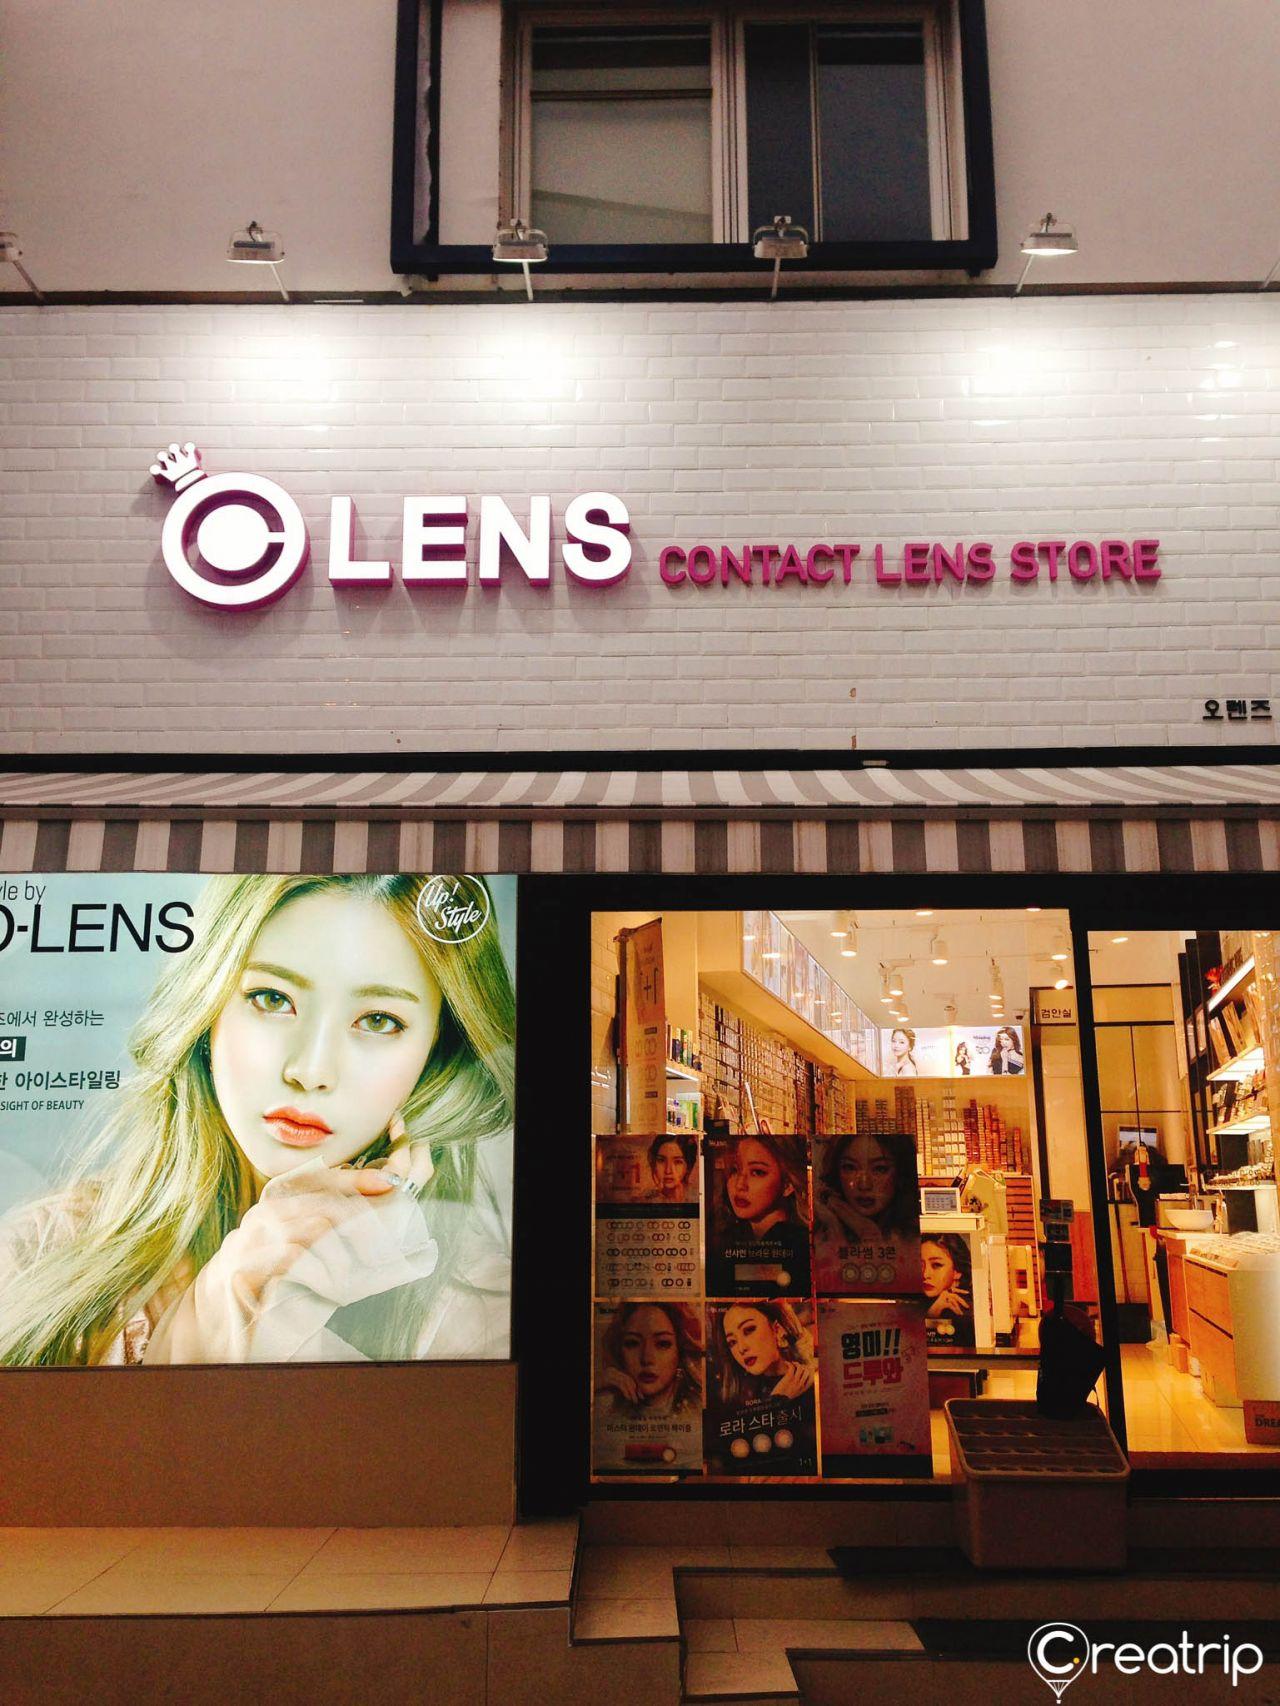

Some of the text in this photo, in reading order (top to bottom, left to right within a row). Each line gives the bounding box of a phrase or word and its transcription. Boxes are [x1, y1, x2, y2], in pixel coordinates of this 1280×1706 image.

[658, 539, 1163, 587] CONTACT LENS STORE
[1203, 700, 1272, 721] 오렌즈
[24, 880, 46, 905] by
[425, 882, 460, 912] Up!
[434, 901, 482, 933] Style
[43, 1010, 105, 1027] 완성하는
[1041, 1008, 1072, 1018] 검안실
[15, 1070, 121, 1090] 아이스타일링
[31, 1100, 44, 1111] OF
[46, 1100, 85, 1111] BEAUTY
[720, 1417, 746, 1438] 로라
[748, 1411, 775, 1430] 스타
